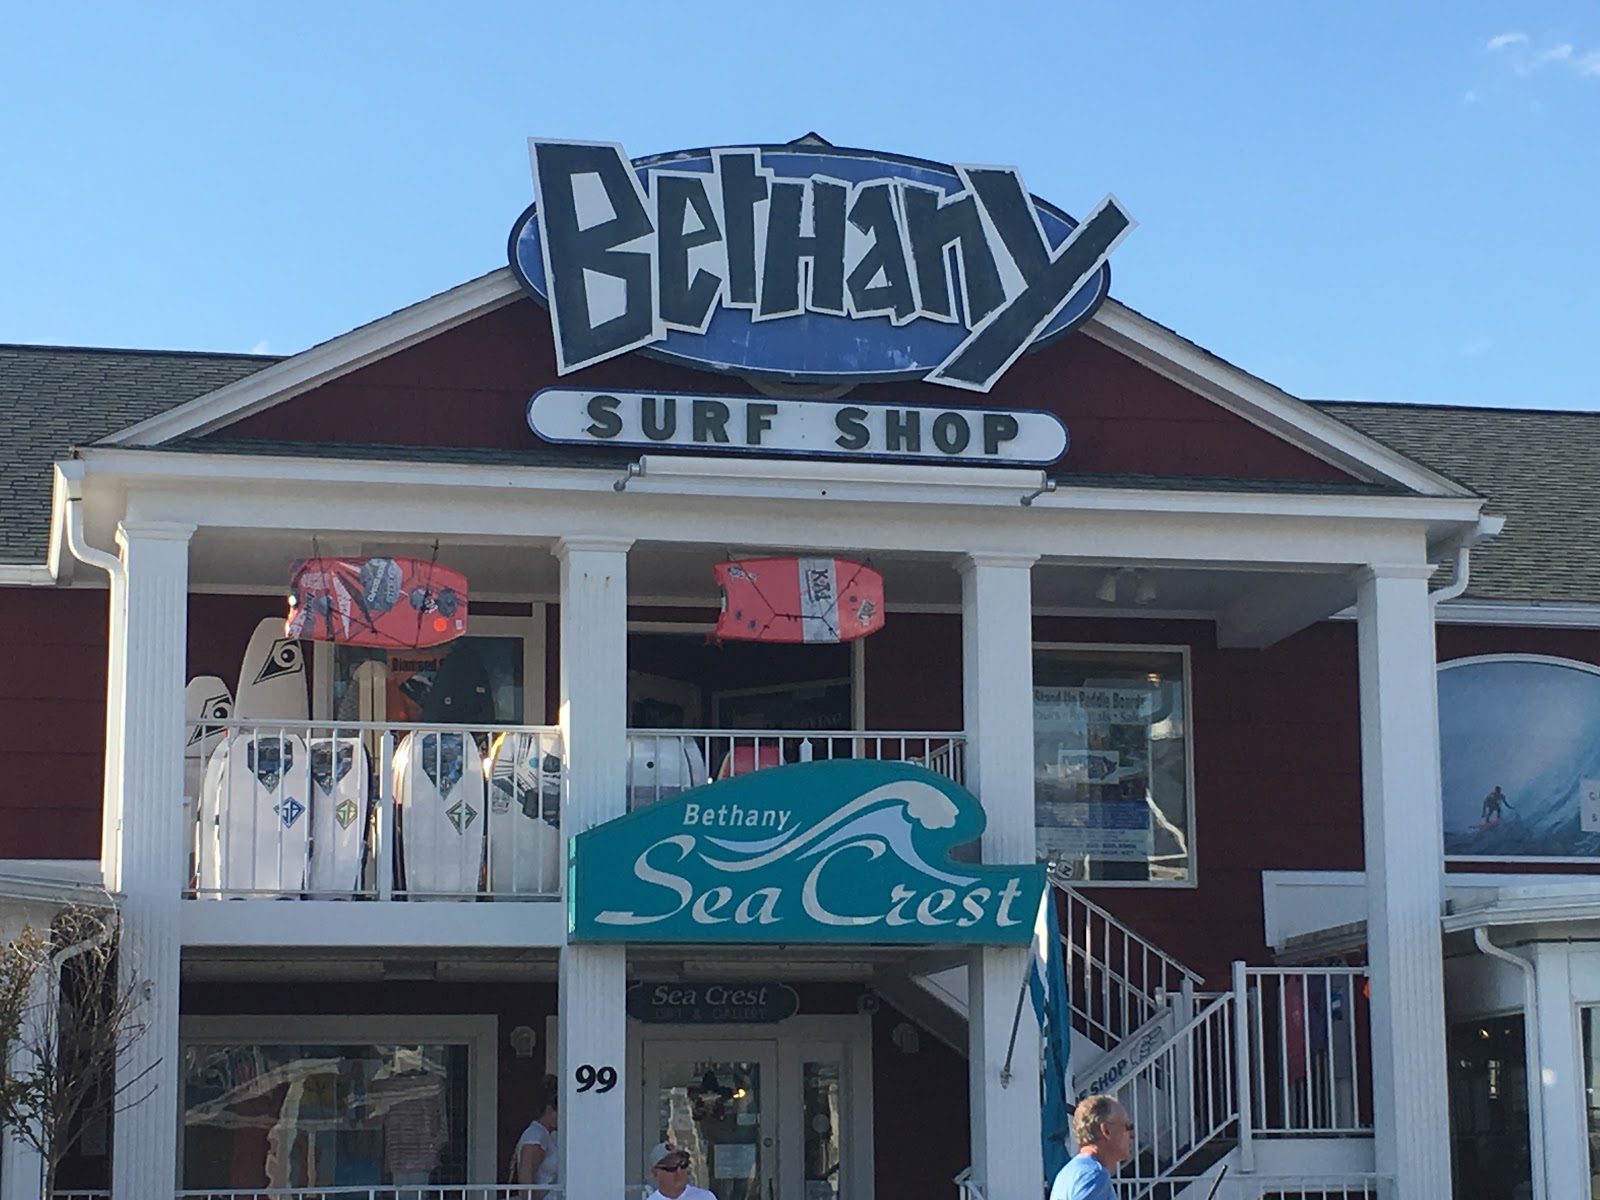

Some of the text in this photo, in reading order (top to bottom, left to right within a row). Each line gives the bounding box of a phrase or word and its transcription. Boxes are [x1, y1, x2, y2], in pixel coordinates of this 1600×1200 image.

[586, 396, 1020, 457] SURF SHOP
[683, 804, 791, 830] Bethany
[594, 834, 1023, 928] Sea Crest
[651, 985, 768, 1005] Sea Crest
[575, 1064, 617, 1094] 99
[1090, 1059, 1128, 1096] SHOP
